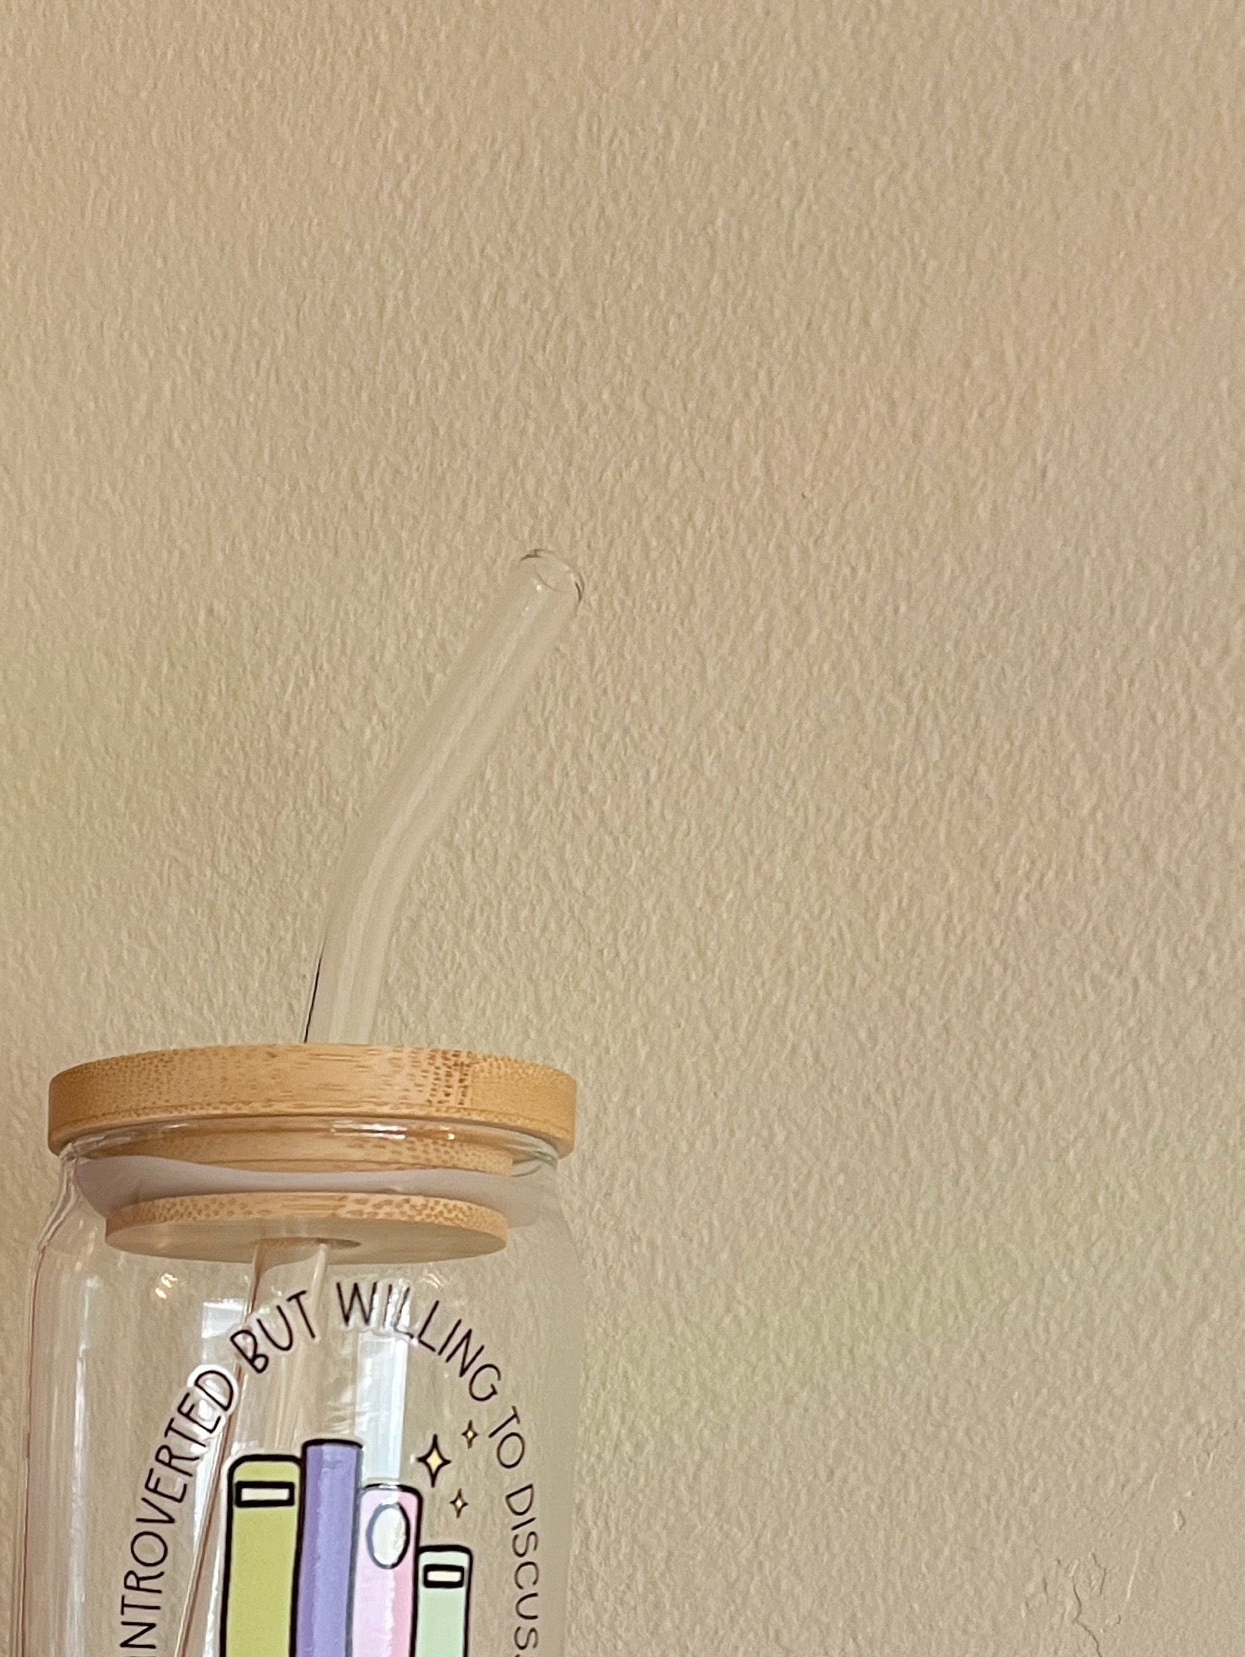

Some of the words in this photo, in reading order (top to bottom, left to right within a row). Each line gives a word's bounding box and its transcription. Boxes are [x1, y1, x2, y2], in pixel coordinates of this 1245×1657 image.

[230, 1290, 319, 1374] BUT
[336, 1281, 503, 1402] WILLING
[487, 1406, 526, 1470] TO
